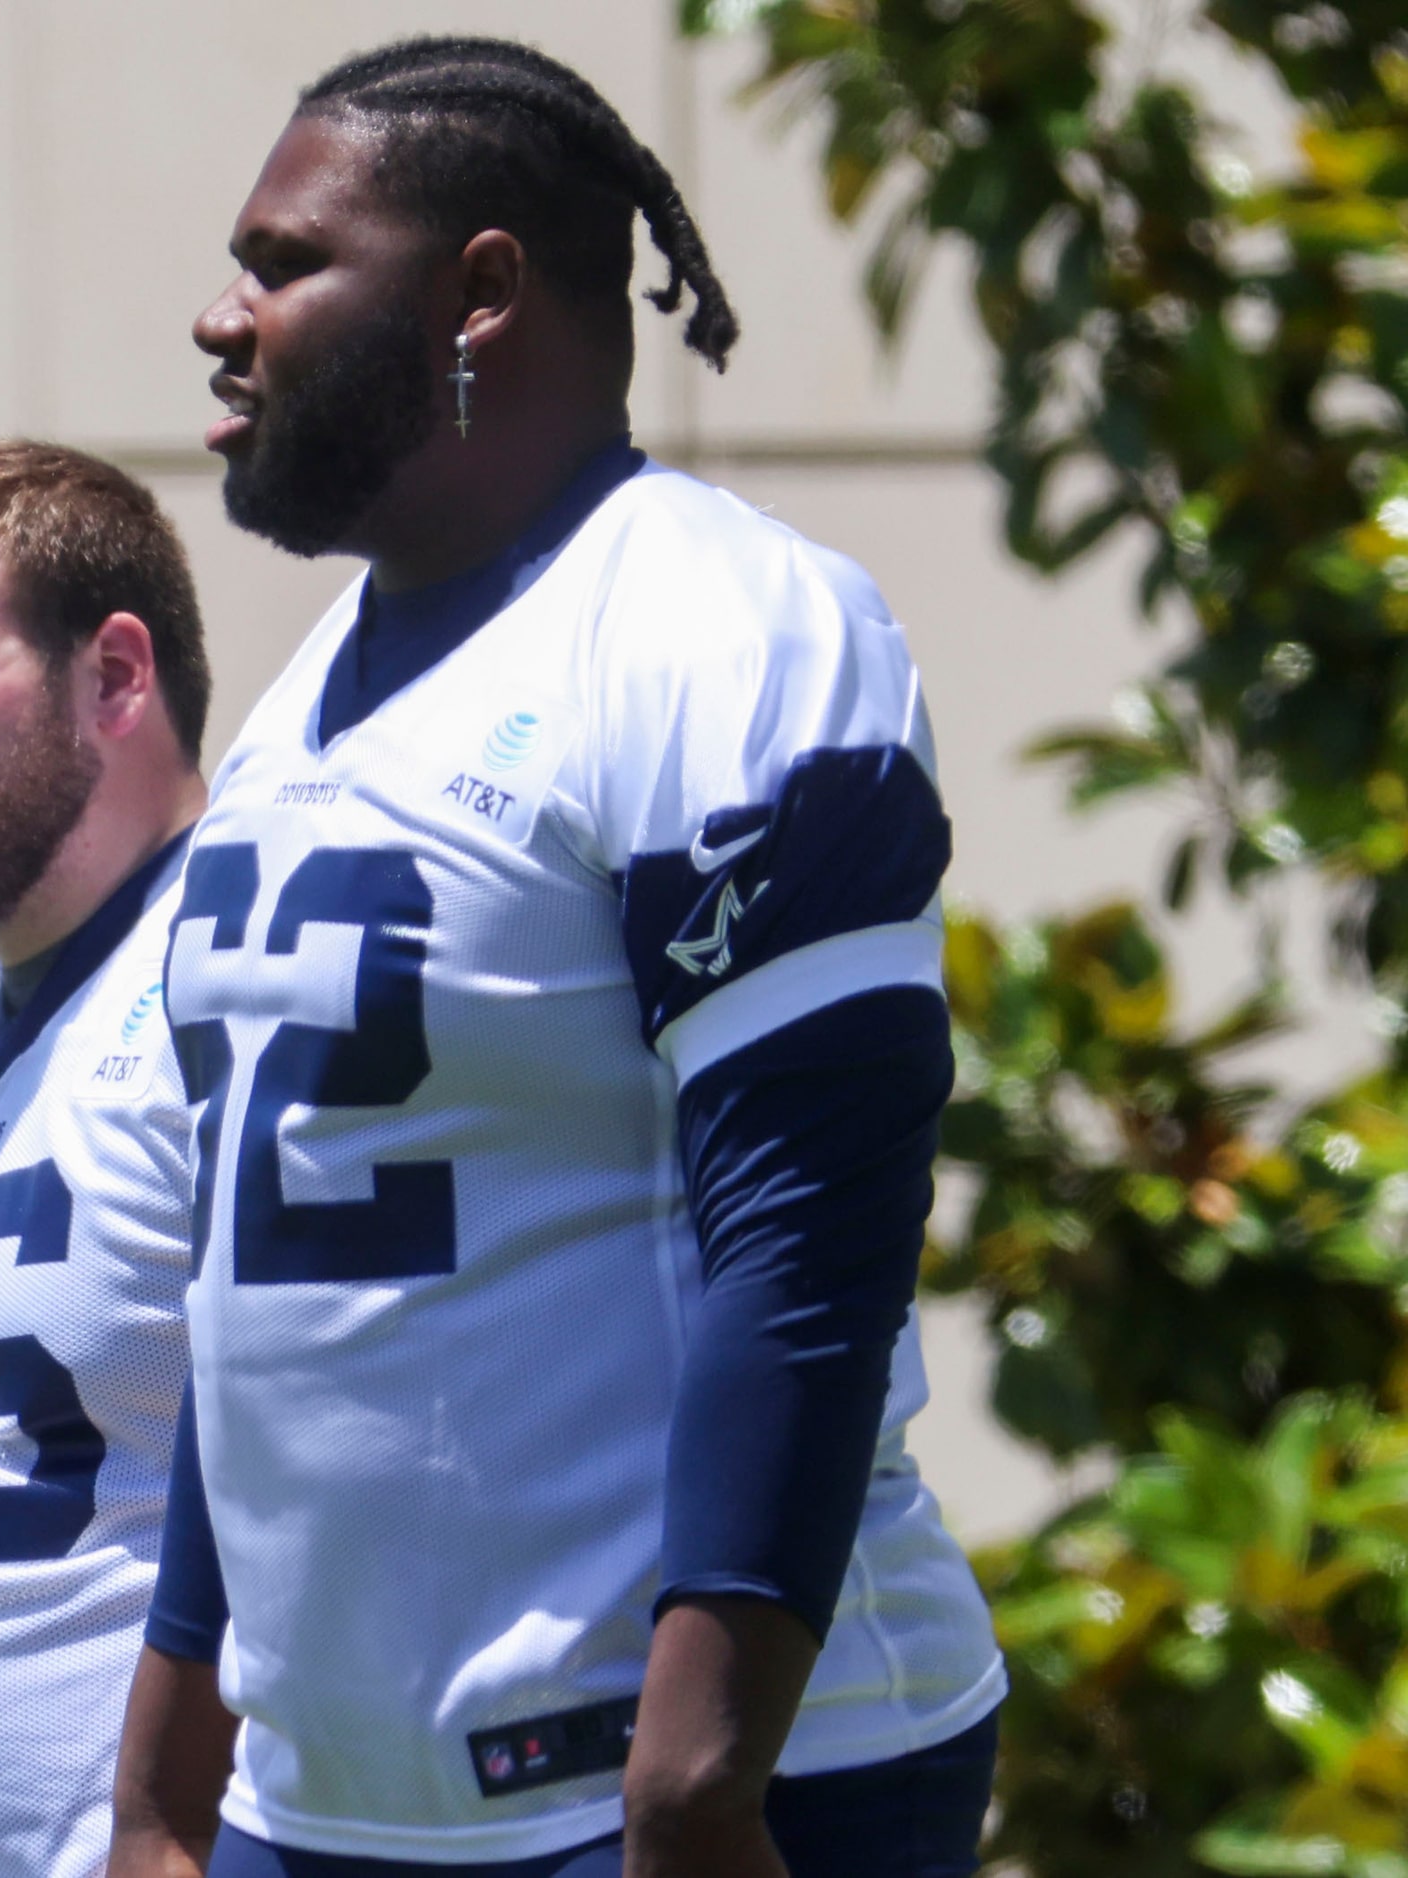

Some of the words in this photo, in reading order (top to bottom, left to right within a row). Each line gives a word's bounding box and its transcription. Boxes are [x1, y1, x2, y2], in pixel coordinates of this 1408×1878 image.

[274, 782, 341, 805] COWBOYS
[440, 772, 516, 822] AT&T
[91, 1055, 143, 1082] AT&T
[163, 842, 456, 1285] 62
